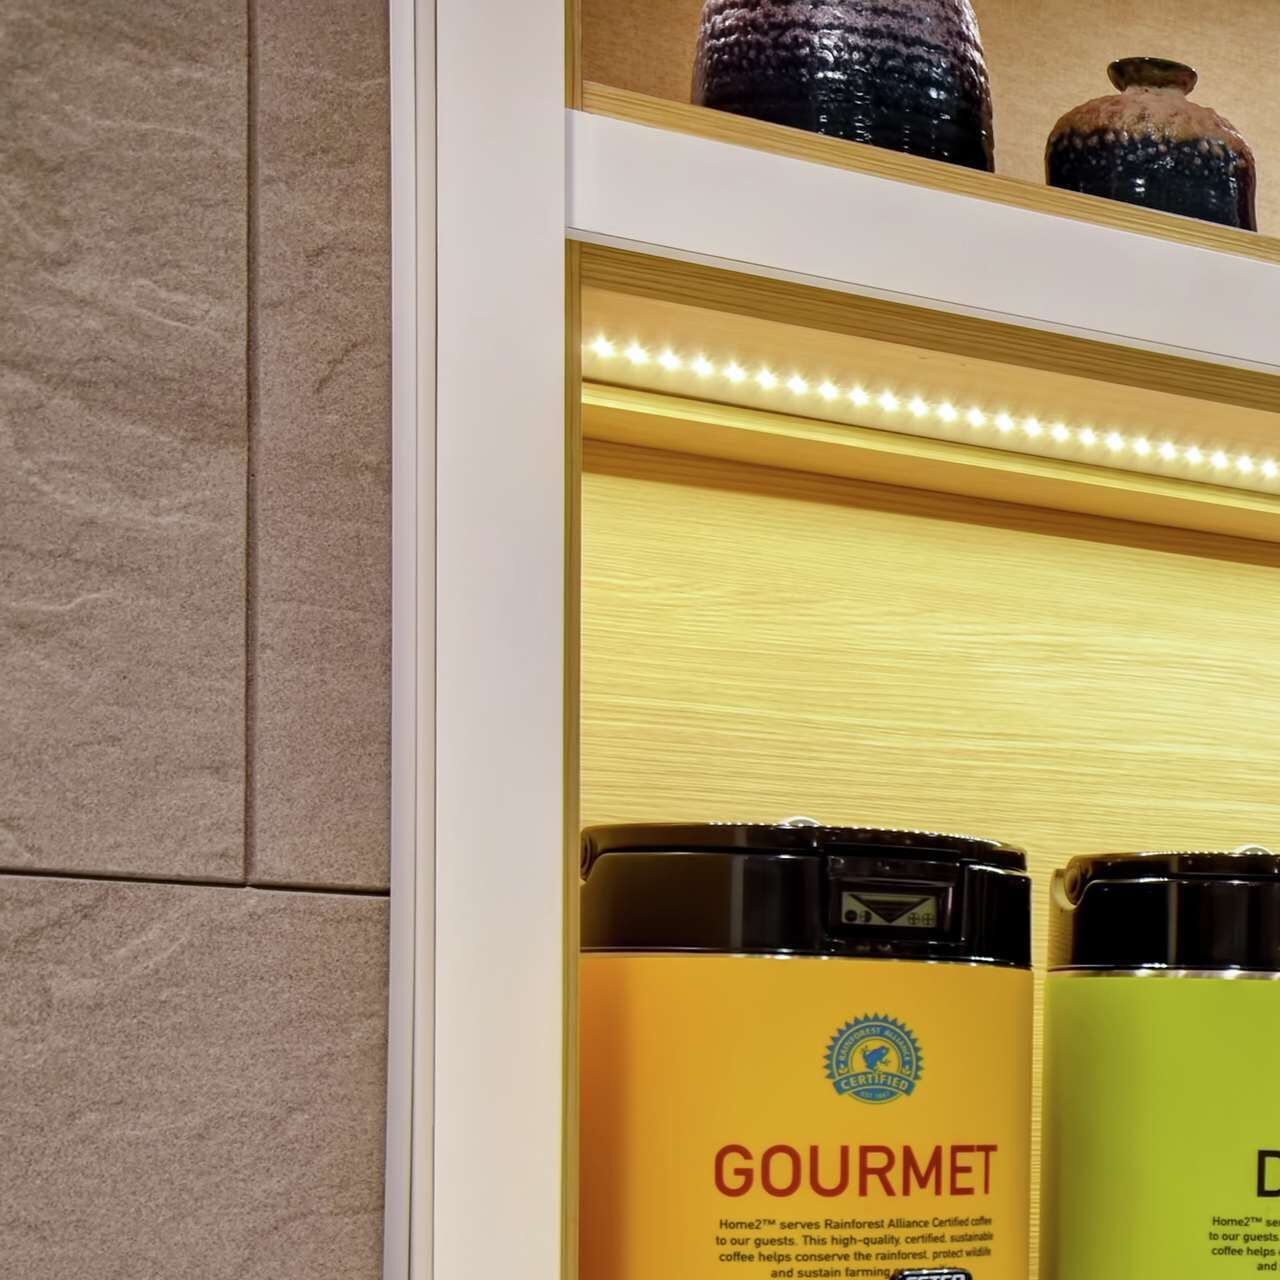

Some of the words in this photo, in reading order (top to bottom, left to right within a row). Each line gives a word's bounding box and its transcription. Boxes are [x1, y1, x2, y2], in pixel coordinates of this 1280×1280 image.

[839, 1026, 881, 1060] RAINFOREST
[841, 1074, 909, 1090] CERTIFIED
[713, 1144, 998, 1198] GOURMET
[780, 1221, 821, 1230] serves
[824, 1218, 885, 1230] Rainforest
[887, 1218, 930, 1228] Alliance
[932, 1216, 969, 1227] Certified
[716, 1236, 727, 1246] to
[730, 1238, 750, 1246] our
[803, 1235, 828, 1246] This
[1208, 1231, 1220, 1241] to
[1222, 1232, 1240, 1241] our
[719, 1251, 755, 1262] coffee
[758, 1251, 792, 1264] helps
[795, 1252, 850, 1262] conserve
[853, 1250, 872, 1261] the
[932, 1248, 963, 1260] protect
[1211, 1246, 1244, 1256] coffee
[1246, 1246, 1276, 1258] helps
[770, 1267, 794, 1278] and
[797, 1267, 841, 1278] sustain
[845, 1266, 891, 1280] farming
[1257, 1261, 1278, 1272] and
